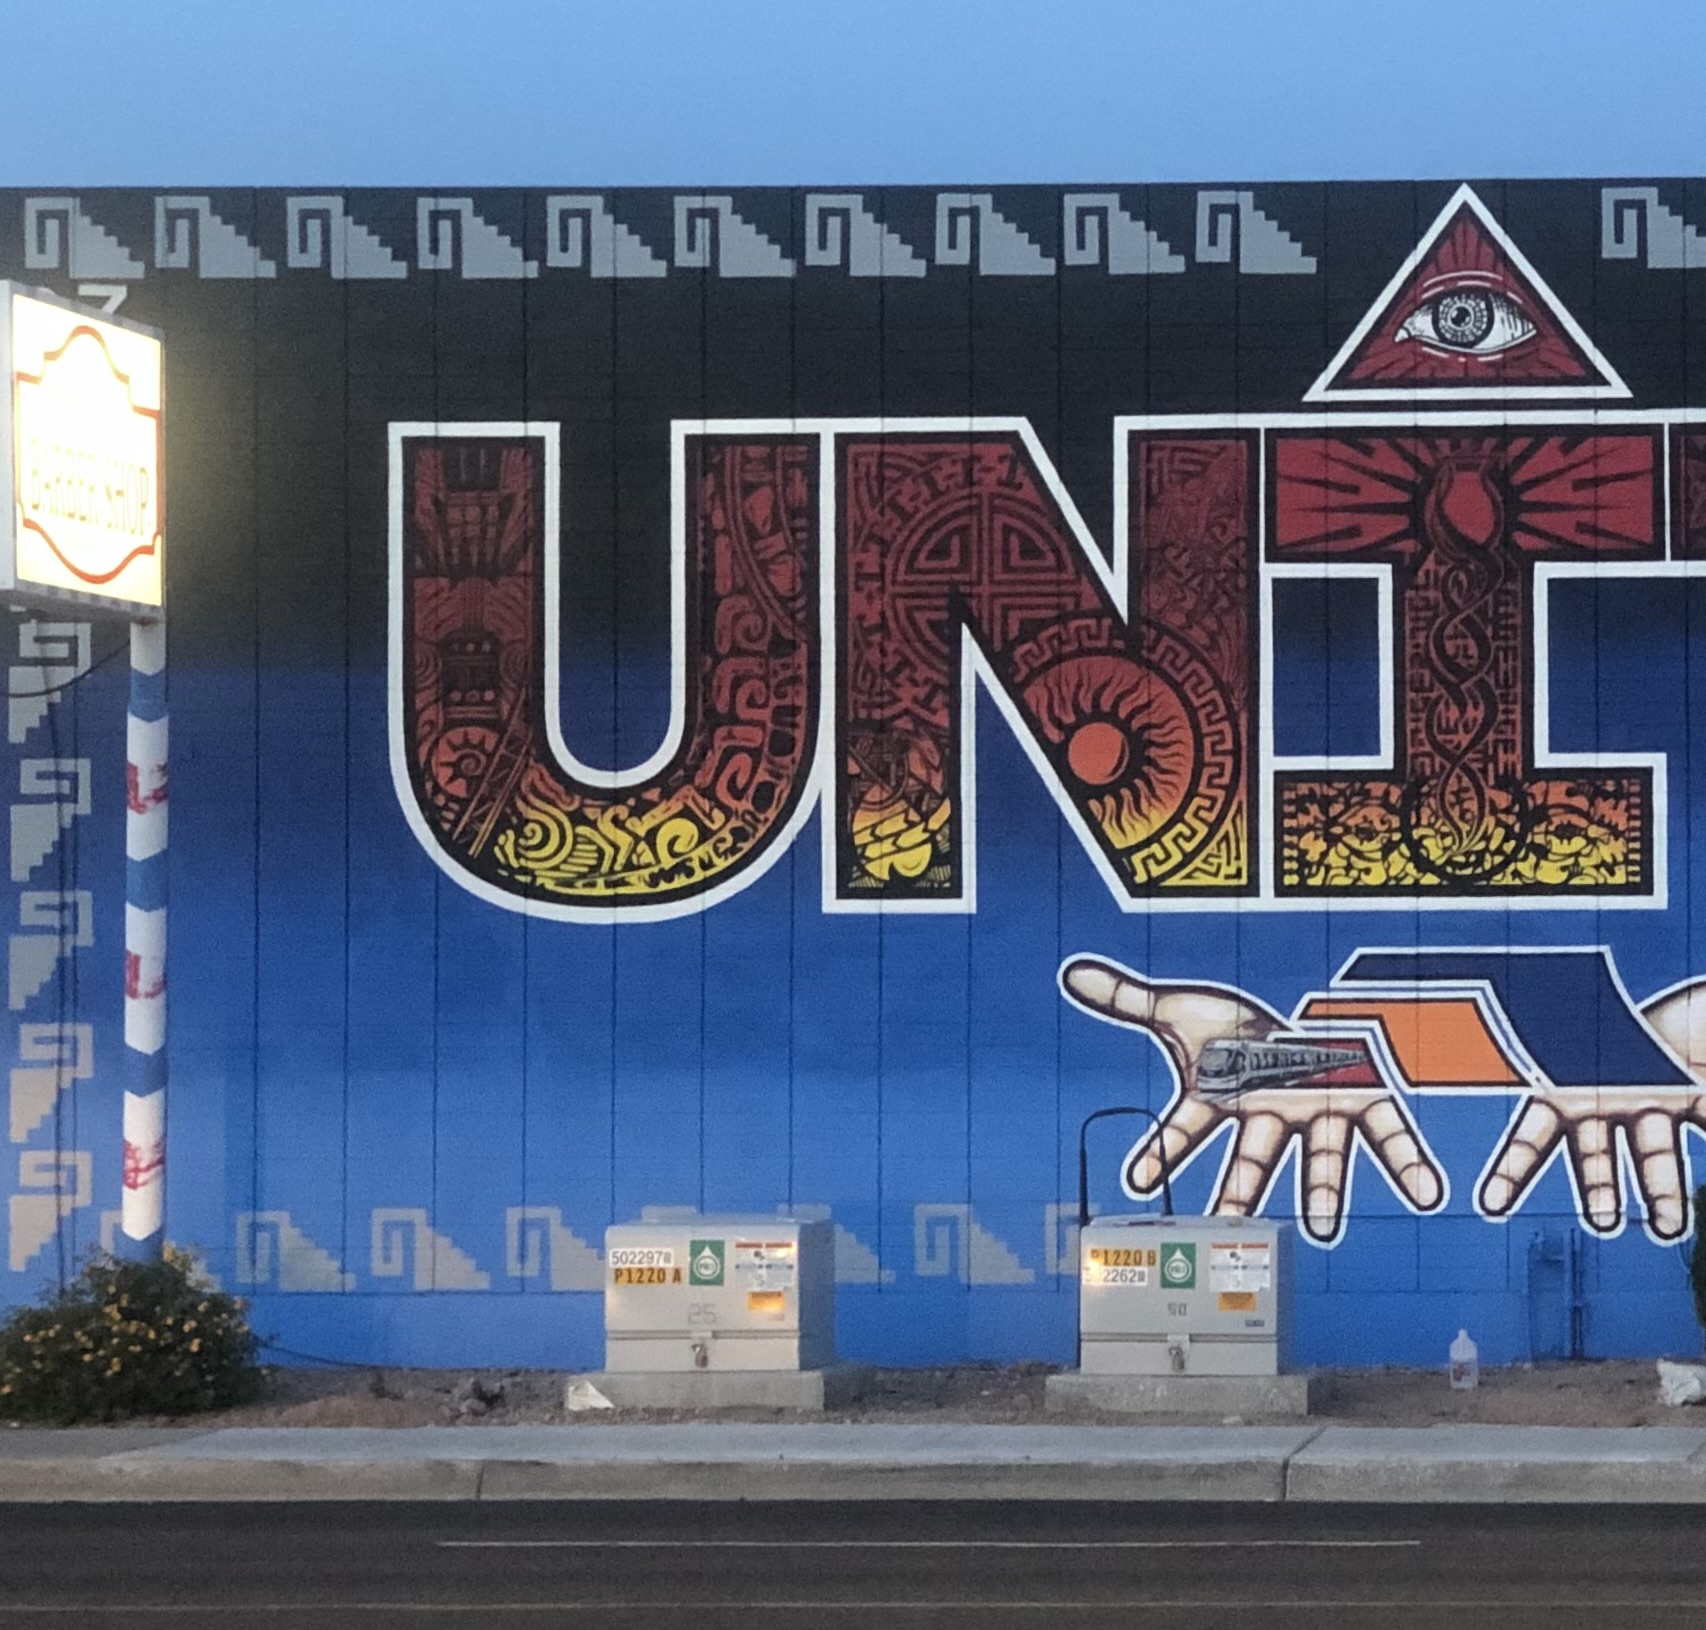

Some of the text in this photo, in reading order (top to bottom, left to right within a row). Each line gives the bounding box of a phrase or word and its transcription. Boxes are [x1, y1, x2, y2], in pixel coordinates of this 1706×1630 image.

[1090, 1249, 1142, 1266] P1220
[614, 1268, 682, 1284] P1220 A
[687, 1303, 716, 1324] 25
